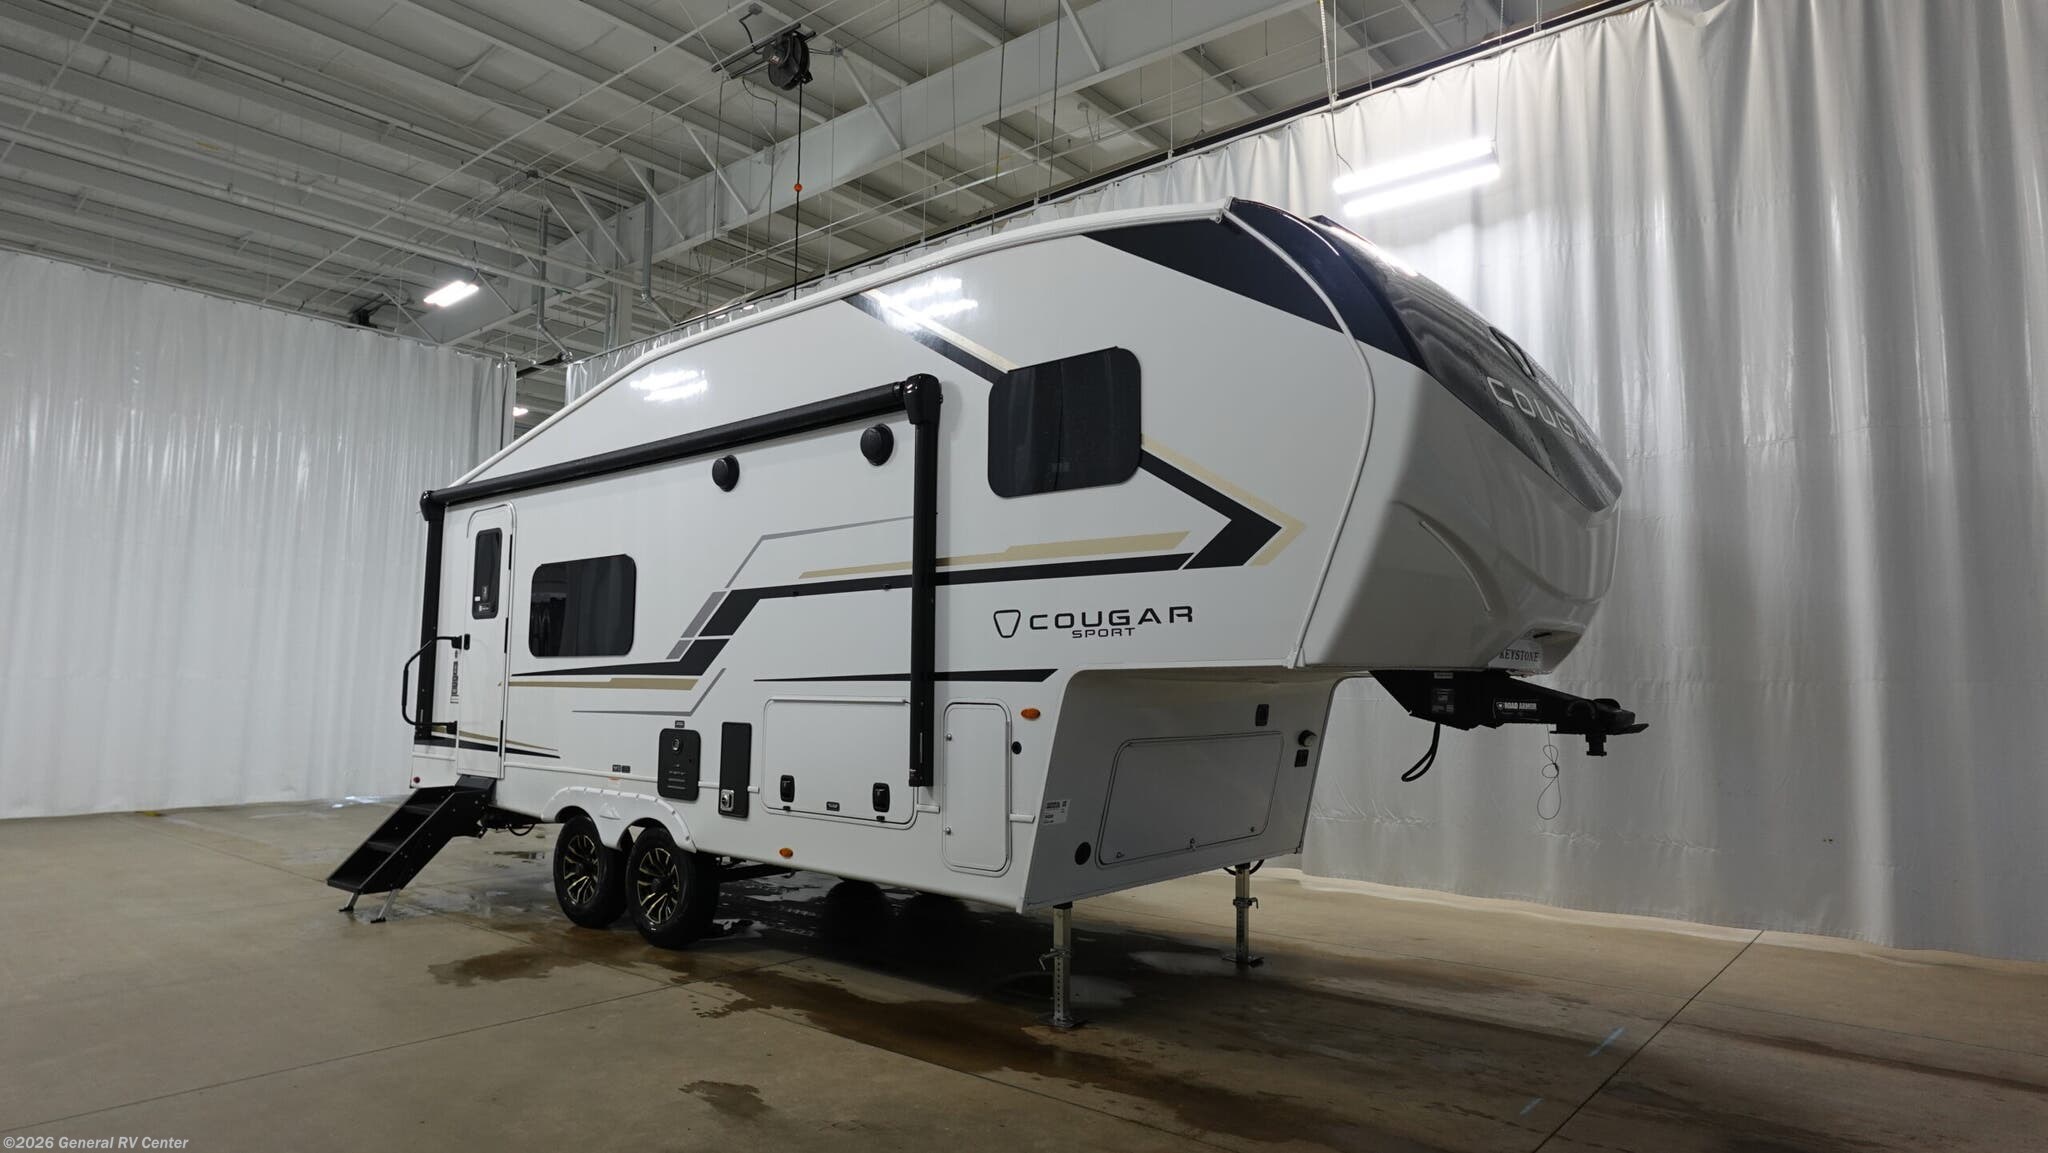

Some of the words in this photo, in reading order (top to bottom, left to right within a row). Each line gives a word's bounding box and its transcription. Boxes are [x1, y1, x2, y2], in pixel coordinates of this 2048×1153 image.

[1486, 376, 1592, 450] COUGA
[1029, 606, 1193, 630] COUGAR
[1071, 627, 1136, 639] SPORT
